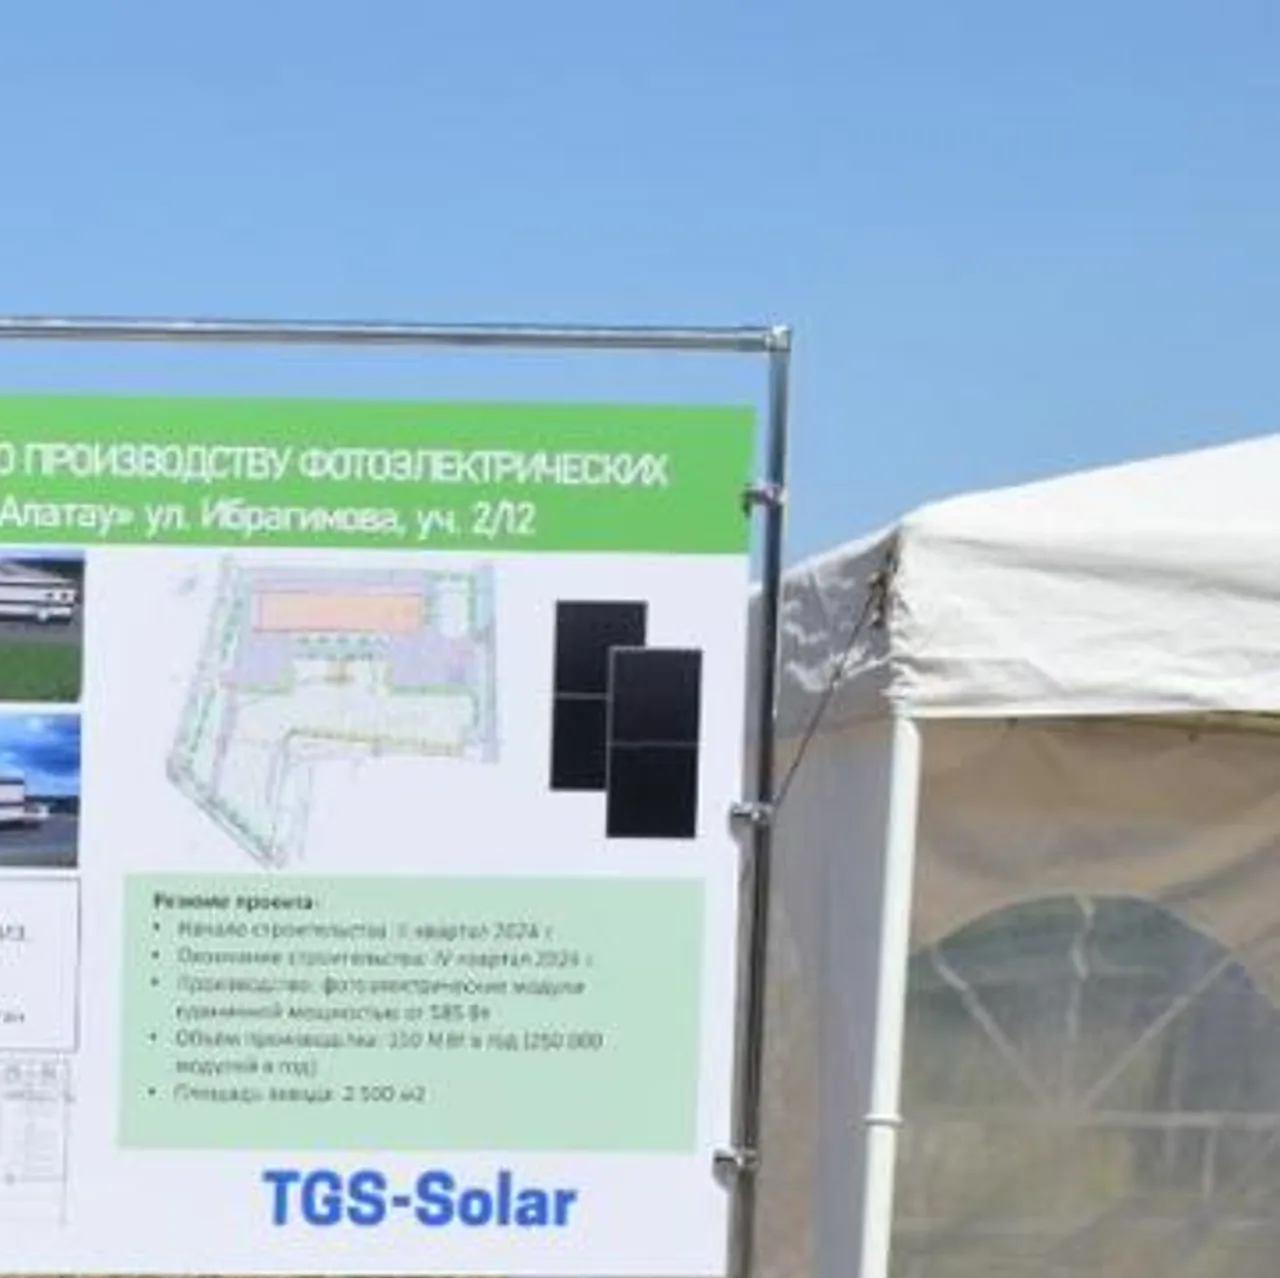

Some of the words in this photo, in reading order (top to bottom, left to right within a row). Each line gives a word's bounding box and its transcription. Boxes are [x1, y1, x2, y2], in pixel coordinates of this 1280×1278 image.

[25, 444, 292, 482] ПРОИЗВОДСТВУ
[299, 447, 669, 487] ФОТОЭЛЕКТРИЧЕСКИХ
[145, 505, 188, 537] ул.
[201, 500, 408, 537] Ибрагимова,
[416, 509, 459, 541] уч.
[472, 502, 536, 540] 2/12
[262, 1168, 578, 1227] TGS-Solar
